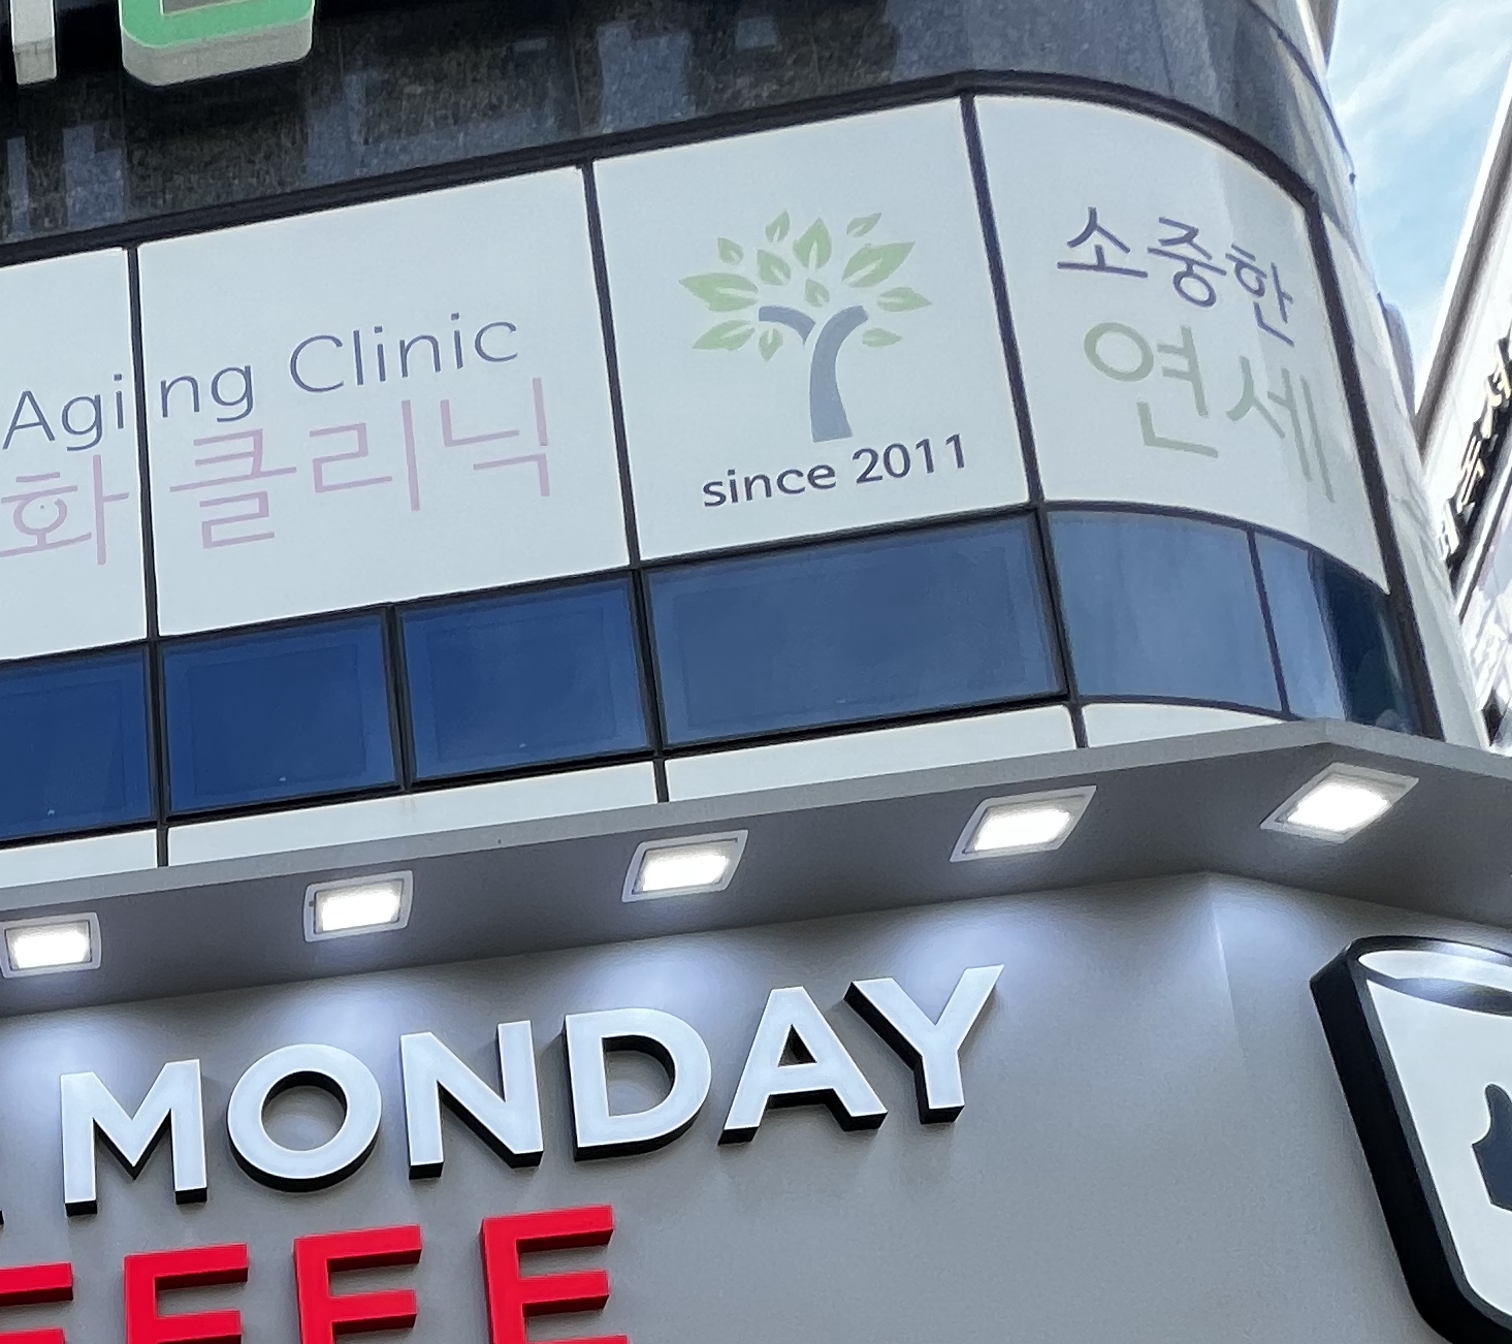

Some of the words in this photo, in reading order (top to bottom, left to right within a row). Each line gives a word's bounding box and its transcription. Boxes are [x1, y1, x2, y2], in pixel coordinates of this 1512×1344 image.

[1057, 206, 1294, 346] 소중한
[1, 360, 254, 458] Aging
[289, 312, 519, 393] Clinic
[169, 377, 551, 551] 클리닉
[1082, 319, 1337, 502] 연세
[701, 458, 837, 508] since
[854, 432, 967, 486] 2011
[60, 964, 1005, 1214] MONDAY
